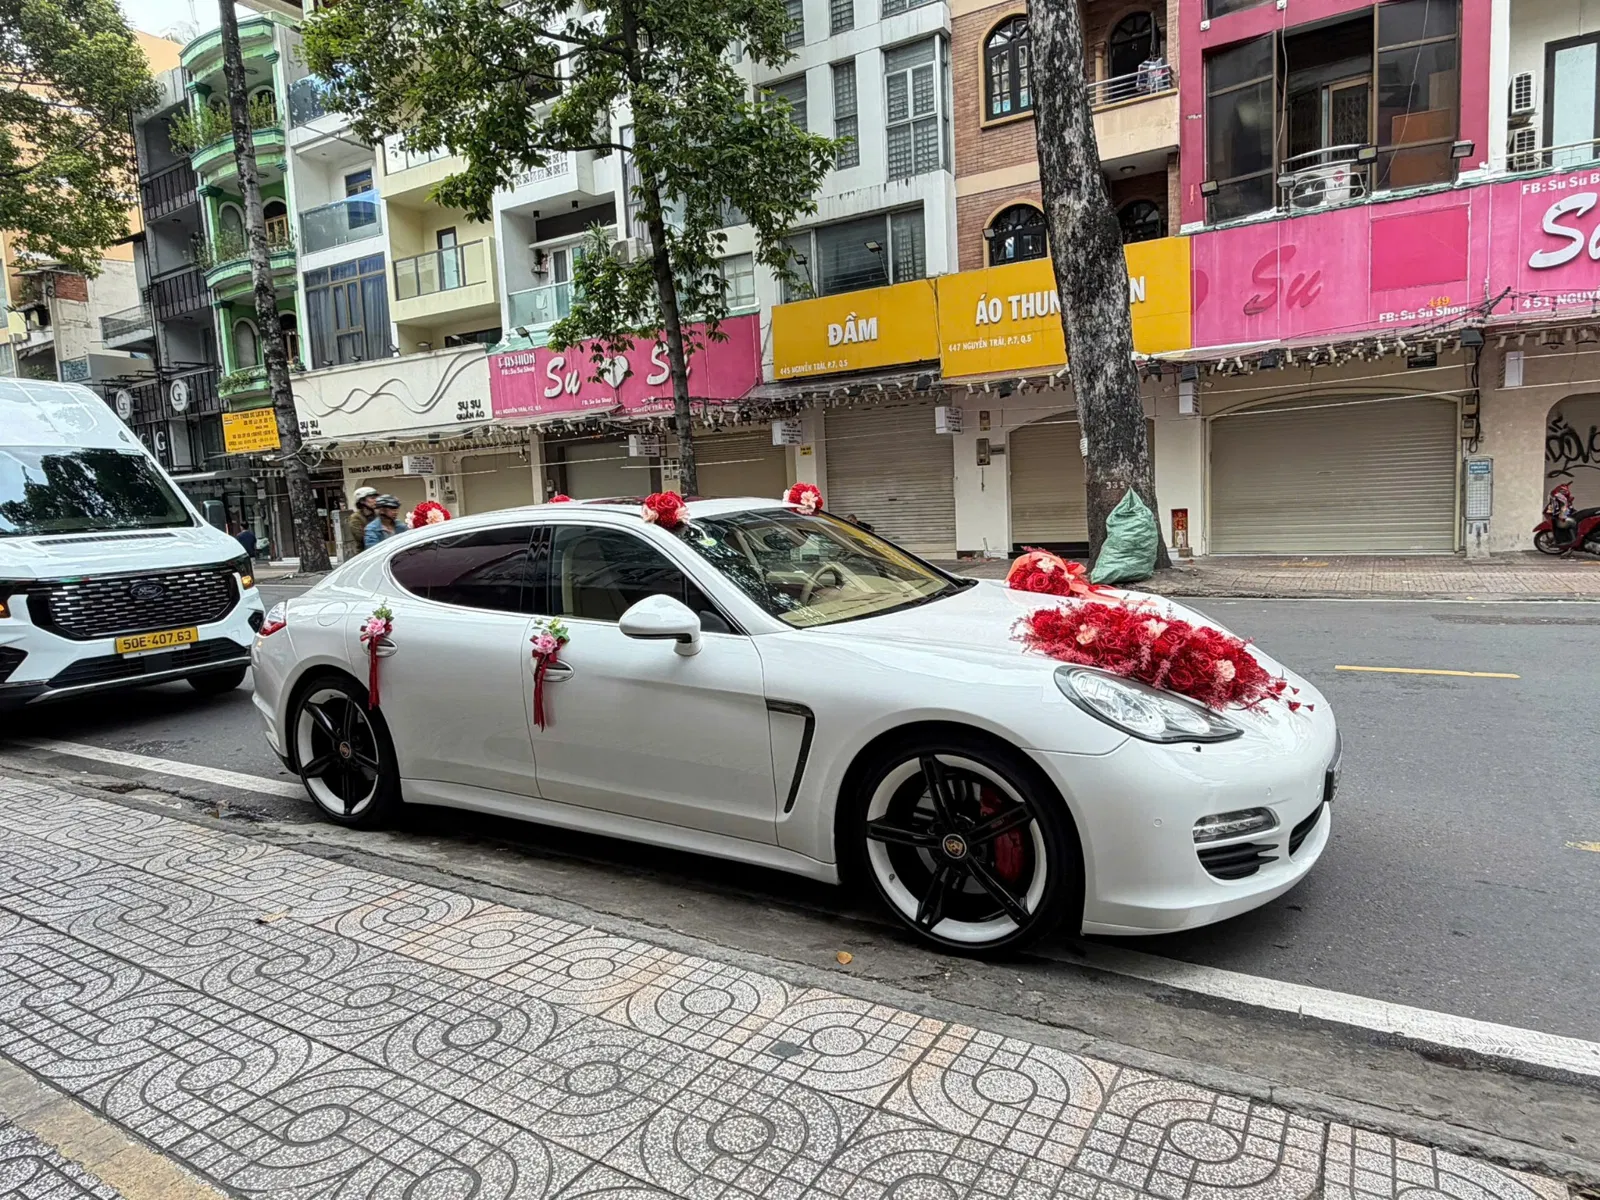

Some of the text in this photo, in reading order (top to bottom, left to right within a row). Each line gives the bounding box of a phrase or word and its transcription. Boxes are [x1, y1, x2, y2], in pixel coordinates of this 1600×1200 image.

[1569, 176, 1588, 188] Su
[1243, 244, 1322, 316] Su
[974, 293, 1002, 326] ÁO
[1008, 289, 1062, 321] THUN
[1427, 296, 1452, 308] 449
[1522, 297, 1550, 309] 451
[1400, 310, 1416, 320] Su
[1418, 308, 1434, 318] Su
[1436, 306, 1466, 317] Shop
[828, 312, 878, 346] ĐẦM
[948, 342, 960, 352] 447
[1020, 334, 1032, 344] Q.5
[498, 352, 536, 368] FASHION
[544, 356, 580, 398] Su
[156, 432, 166, 450] G
[1106, 481, 1125, 490] 335
